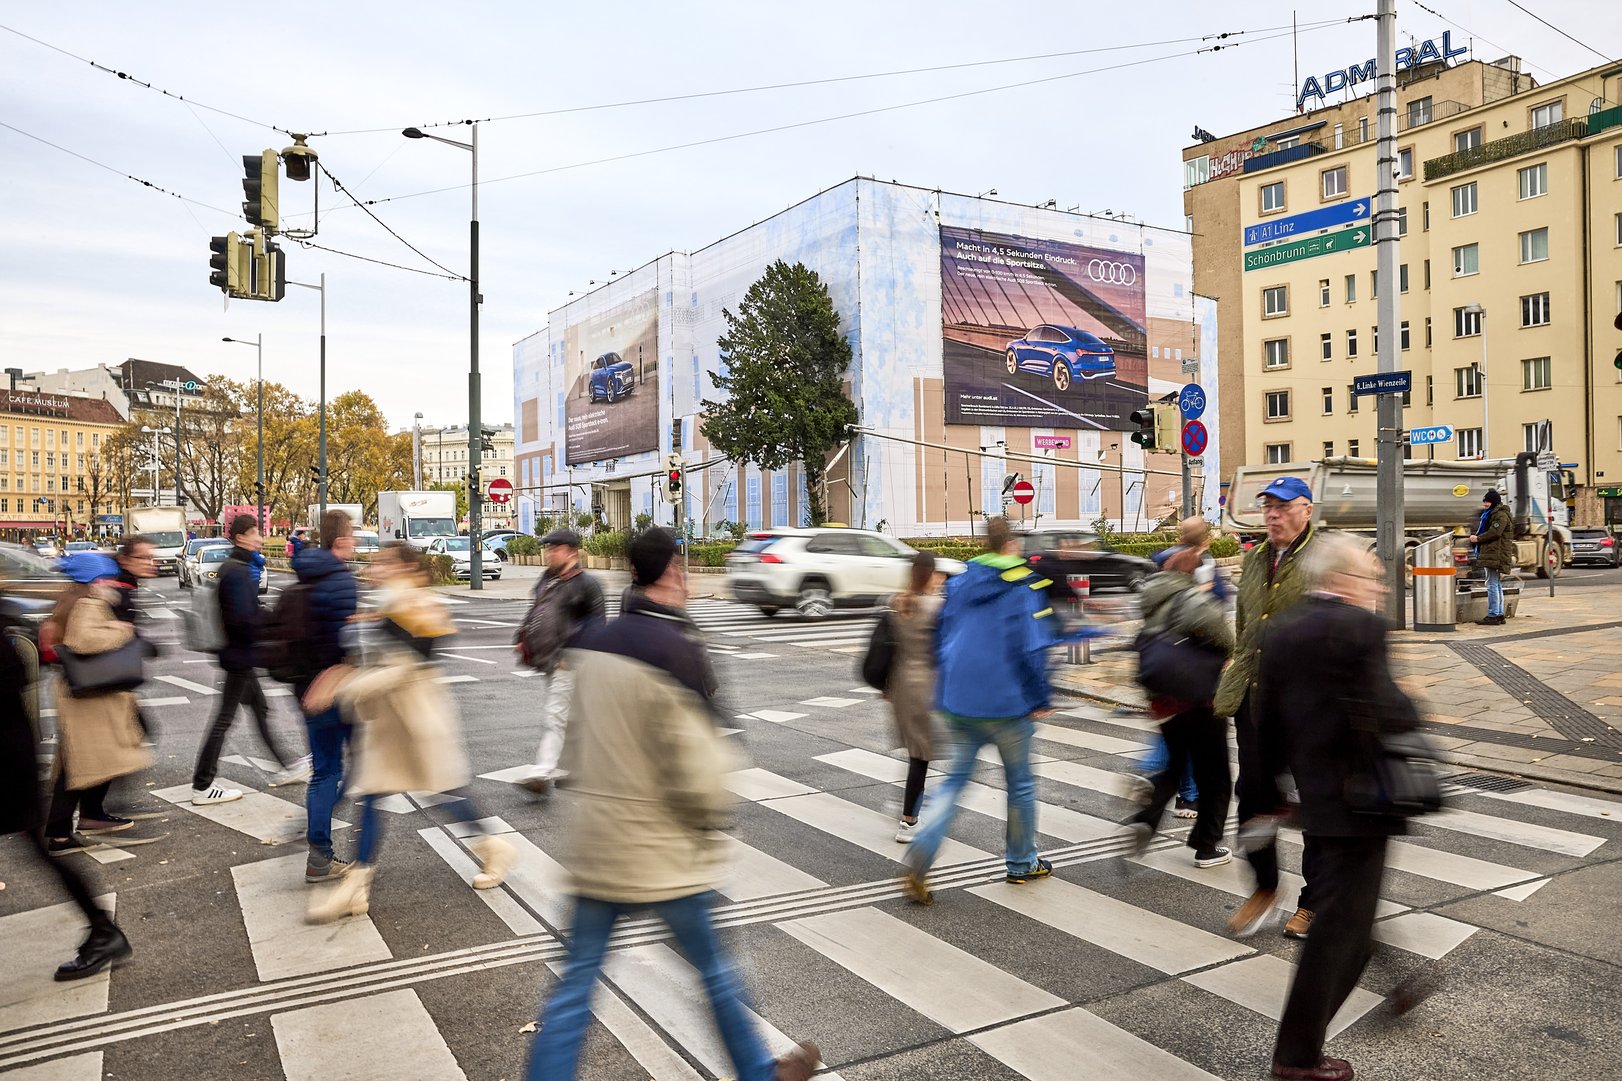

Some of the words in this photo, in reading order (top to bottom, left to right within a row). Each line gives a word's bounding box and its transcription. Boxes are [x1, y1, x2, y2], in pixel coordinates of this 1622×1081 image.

[1297, 30, 1467, 105] ADMRAL
[1262, 225, 1271, 238] A1
[1274, 222, 1294, 234] Linz
[956, 242, 980, 252] Macht
[992, 247, 1004, 256] 4,5
[1006, 249, 1042, 260] Sekunden
[1044, 254, 1077, 265] Eindruck.
[956, 252, 976, 261] Auch
[978, 254, 991, 263] auf
[993, 256, 1005, 264] die
[1006, 258, 1046, 269] Sportsitze.
[1248, 246, 1306, 266] Schönbrunn
[1378, 378, 1406, 388] Wienzeile
[34, 399, 69, 408] MUSEUM
[1412, 432, 1427, 441] WC
